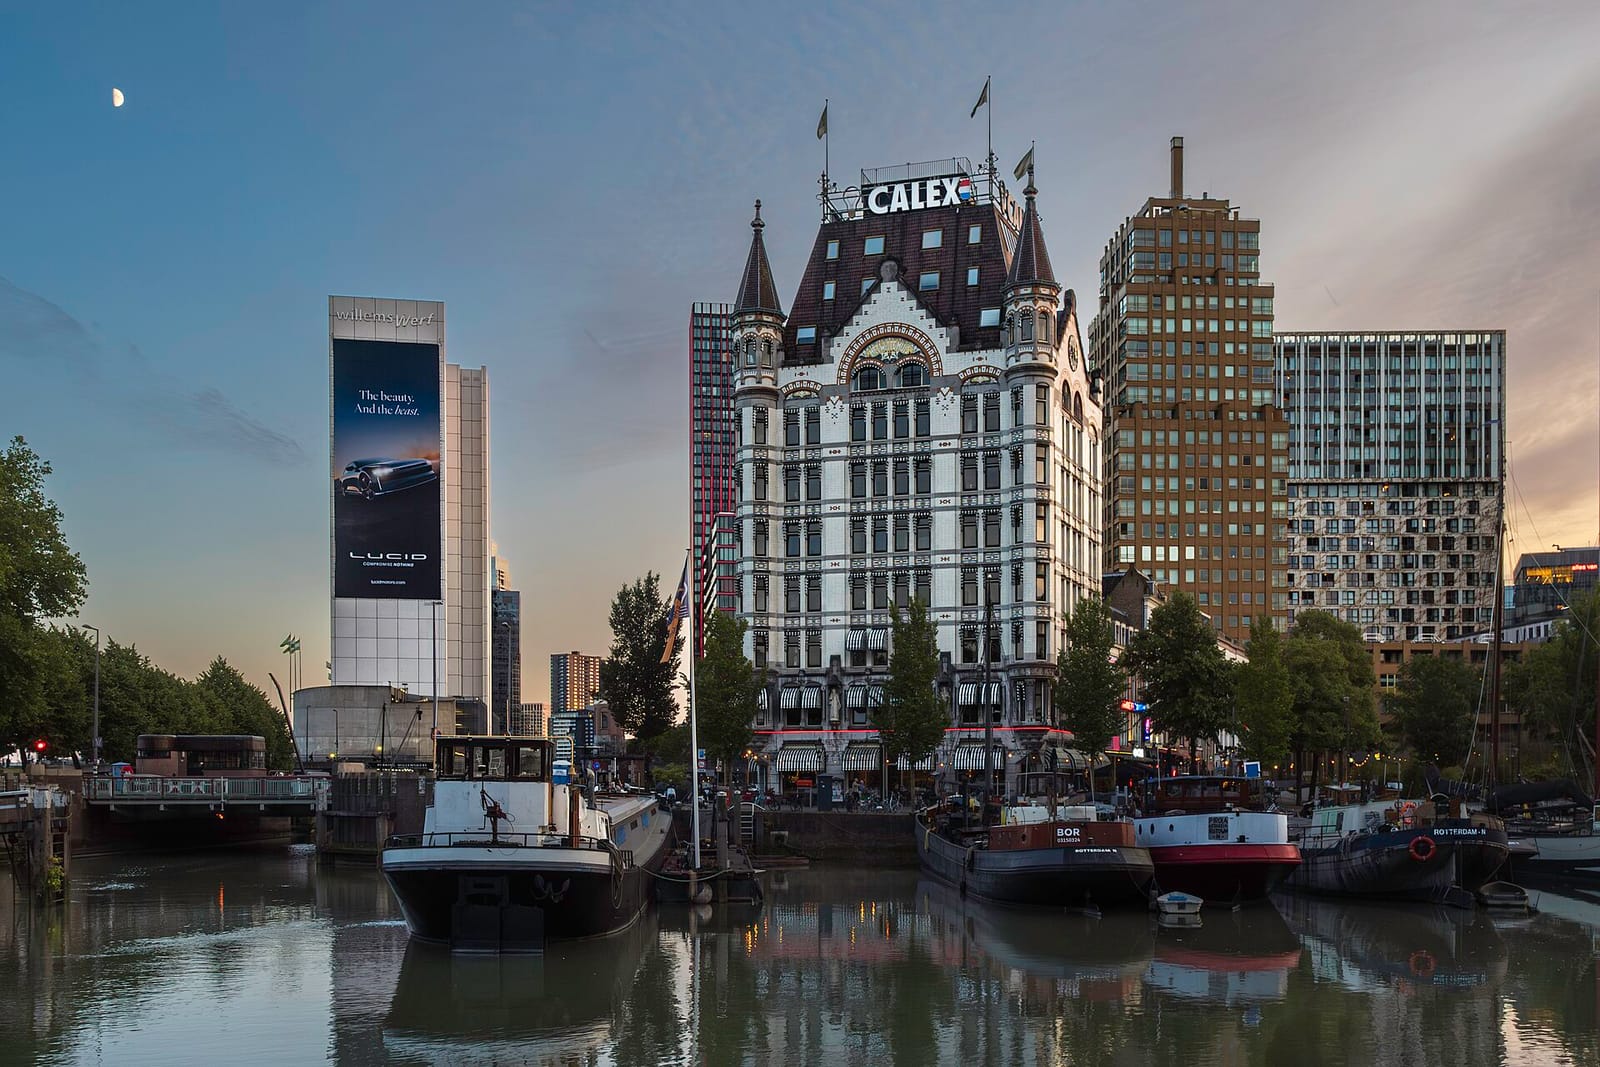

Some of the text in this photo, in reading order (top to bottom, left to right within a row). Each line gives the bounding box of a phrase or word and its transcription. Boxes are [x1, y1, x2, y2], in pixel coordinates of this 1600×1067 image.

[868, 176, 961, 214] CALEX
[359, 390, 414, 405] The beauty.
[354, 403, 420, 415] And the beast.
[350, 551, 427, 560] LUCID
[1057, 828, 1080, 836] BOR
